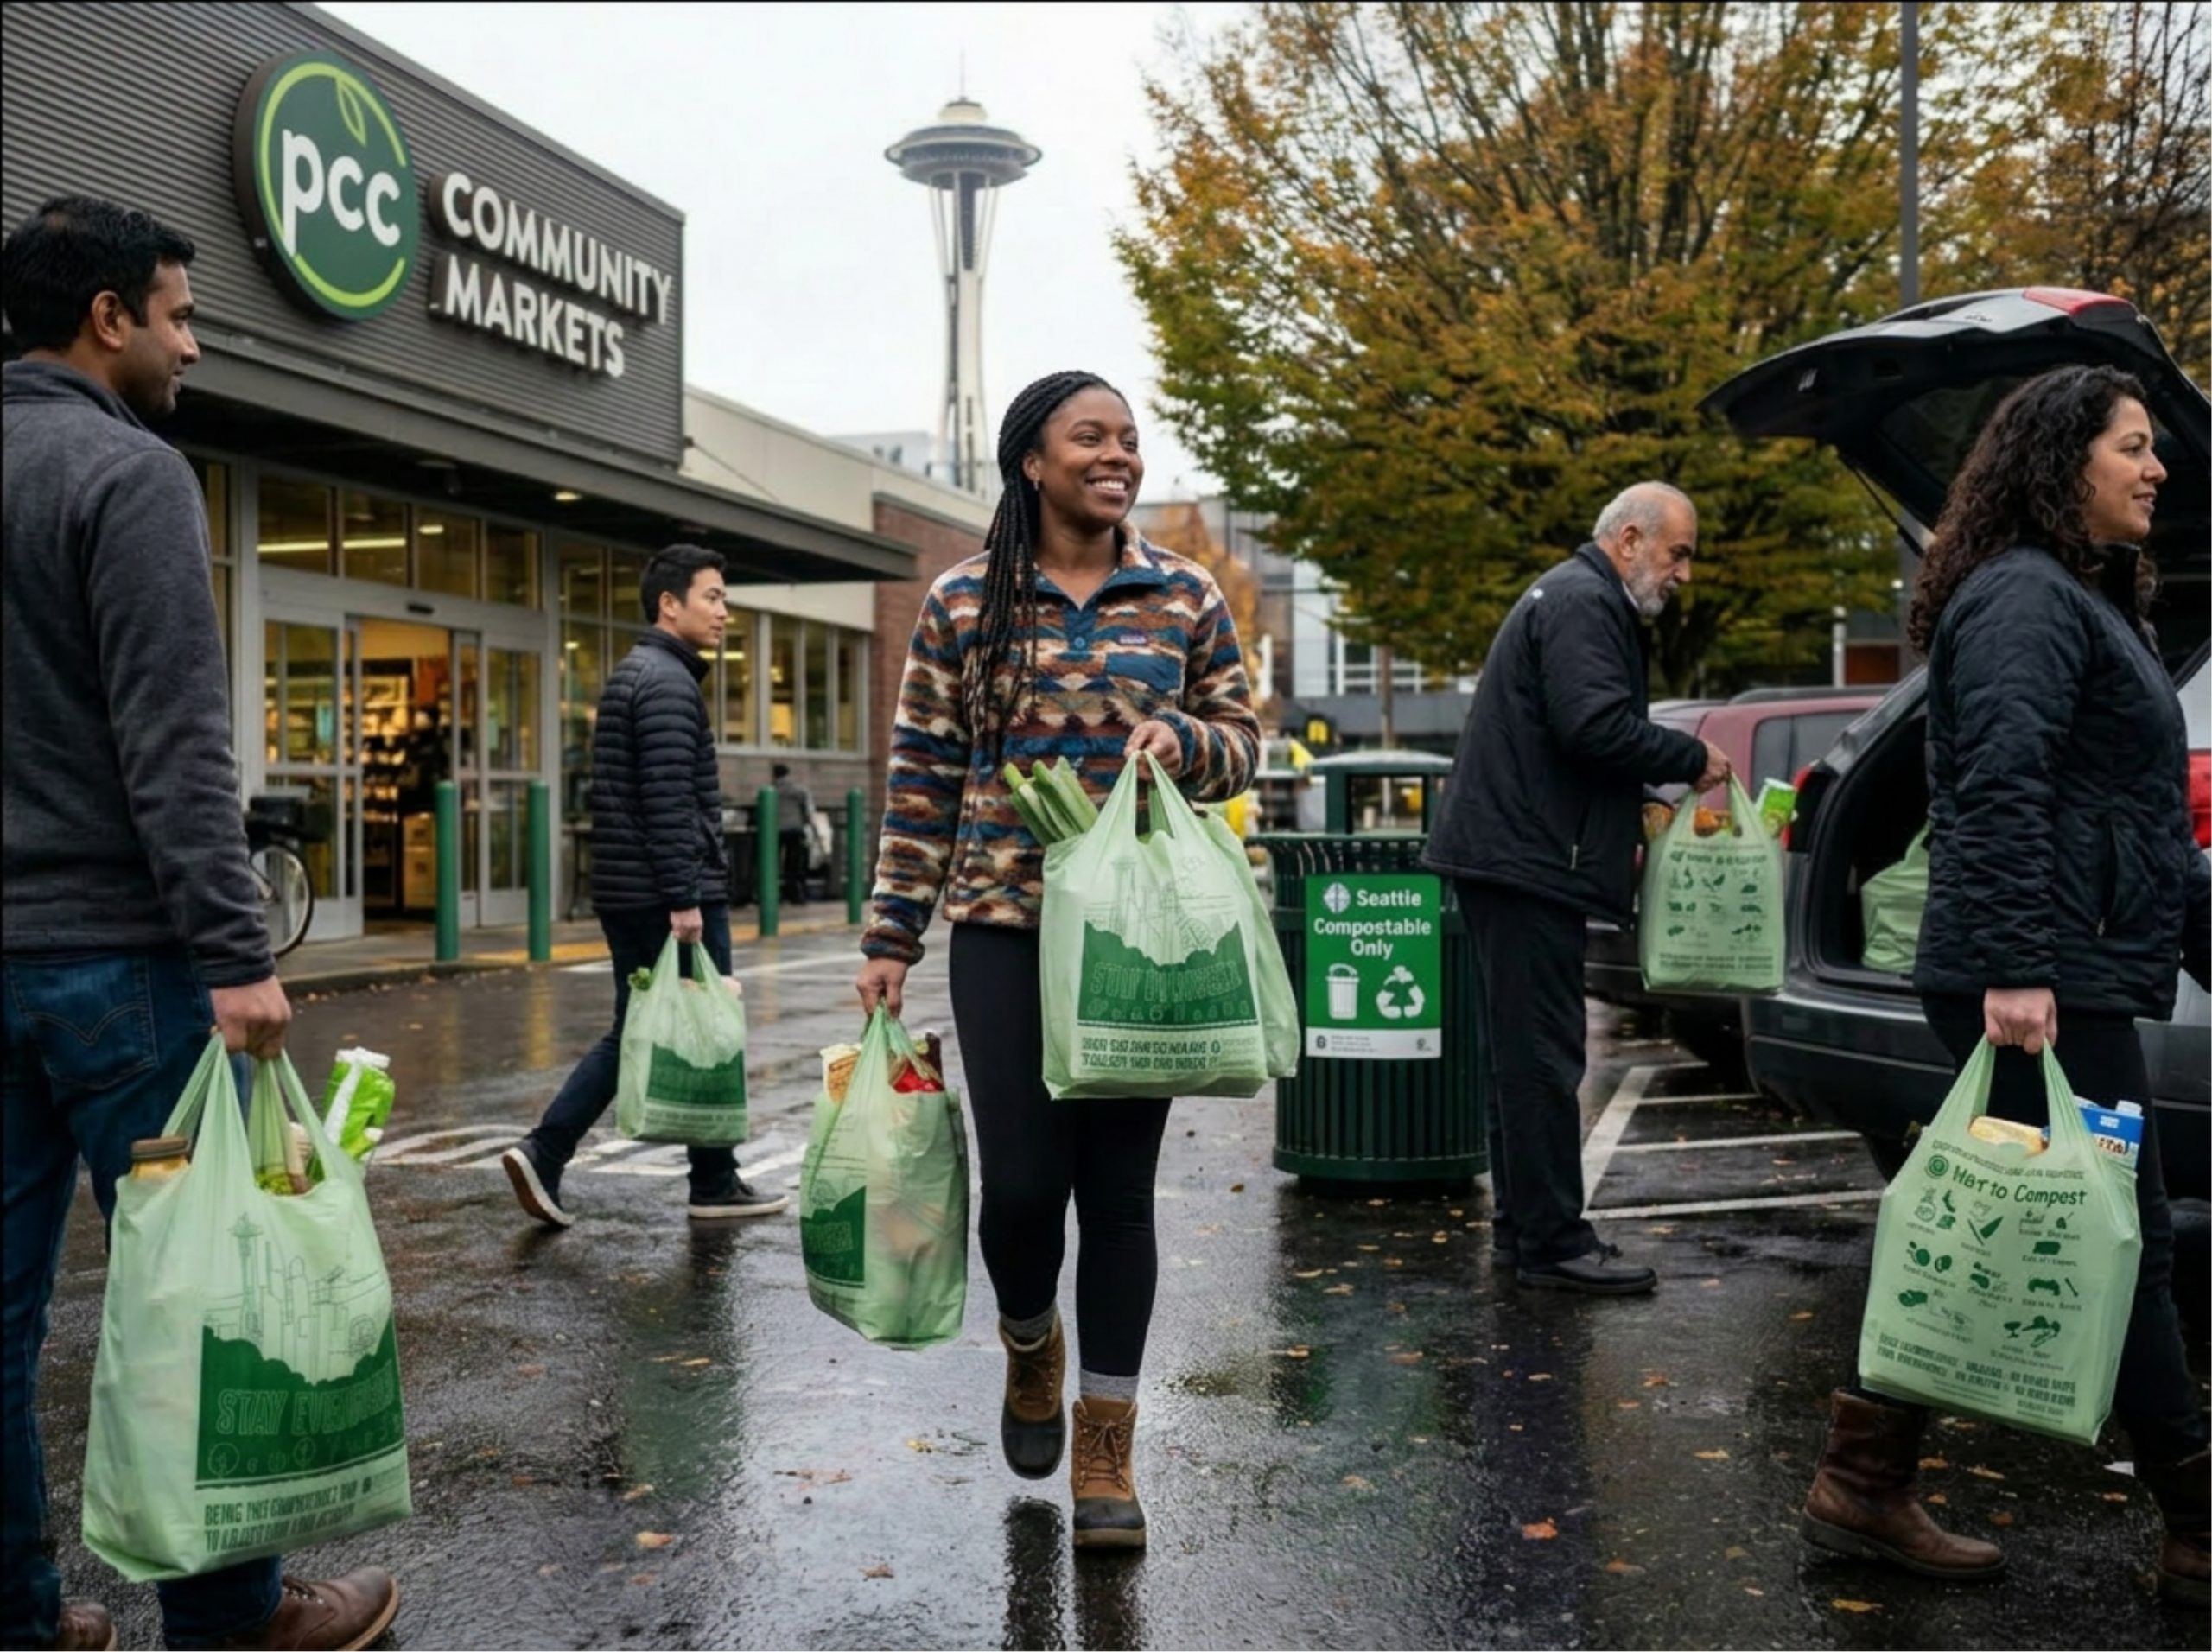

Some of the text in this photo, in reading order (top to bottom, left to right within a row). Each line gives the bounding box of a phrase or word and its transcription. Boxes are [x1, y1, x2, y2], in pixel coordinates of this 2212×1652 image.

[283, 129, 401, 258] pcc
[442, 172, 672, 326] COMMUNITY
[445, 254, 625, 378] MARKETS
[1313, 917, 1431, 938] Compostable
[1351, 938, 1394, 961] Only
[216, 1388, 288, 1436] STAY
